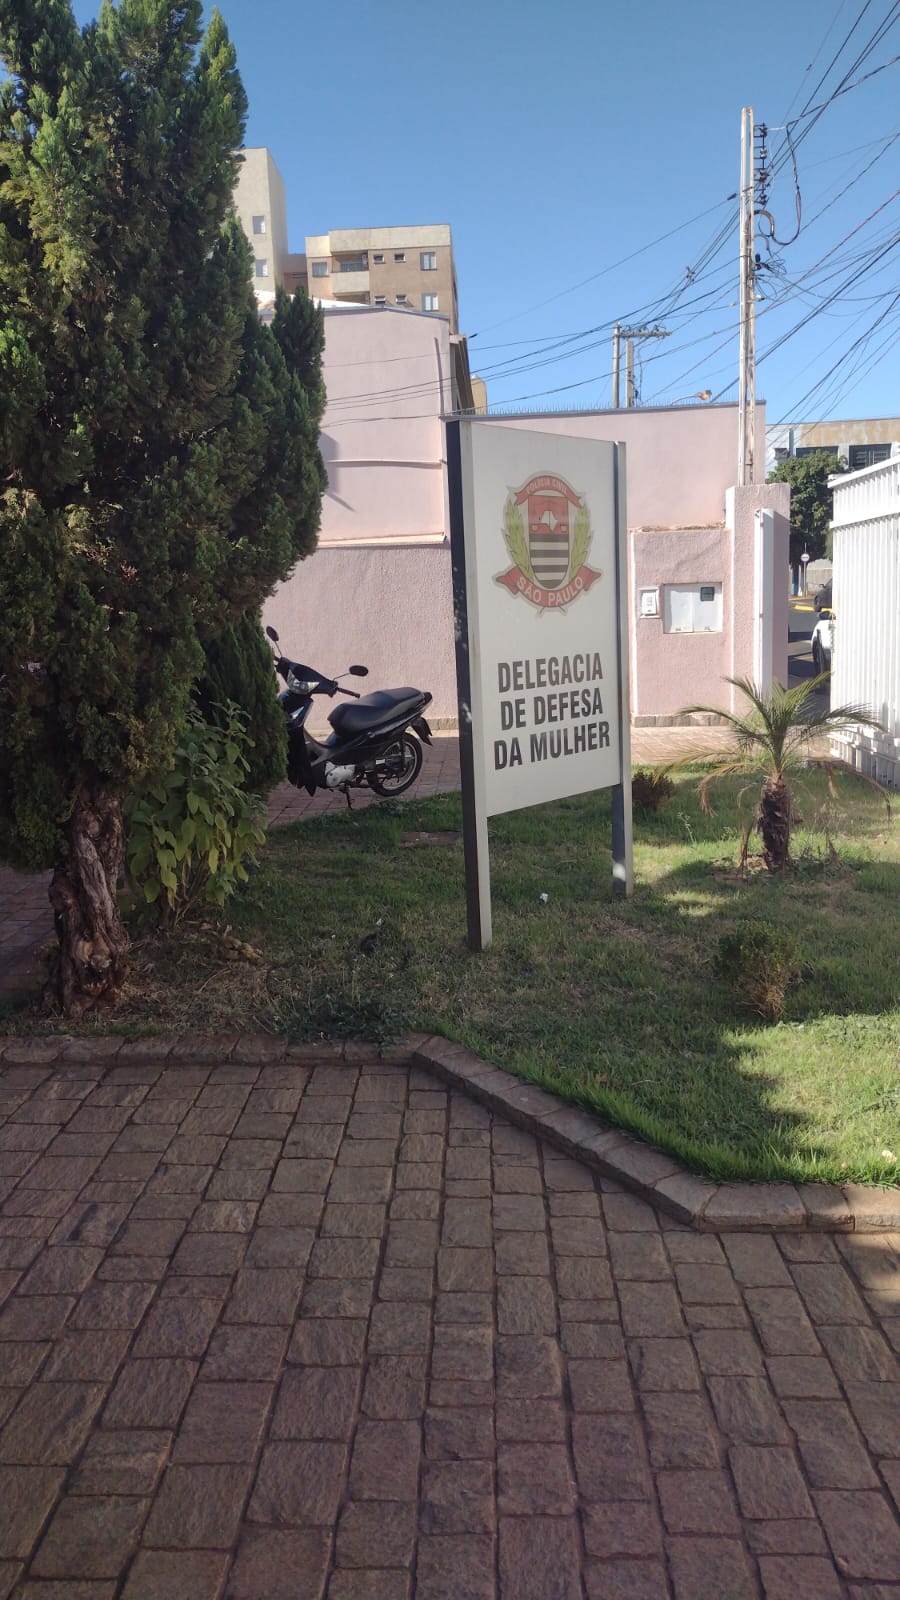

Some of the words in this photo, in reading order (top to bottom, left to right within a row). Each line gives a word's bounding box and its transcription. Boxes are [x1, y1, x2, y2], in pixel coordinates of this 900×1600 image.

[548, 576, 583, 606] PAULO
[498, 652, 603, 693] DELEGACIA
[500, 698, 526, 731] DE
[533, 688, 603, 725] DEFESA
[494, 737, 522, 770] DA
[530, 721, 610, 762] MULHER
